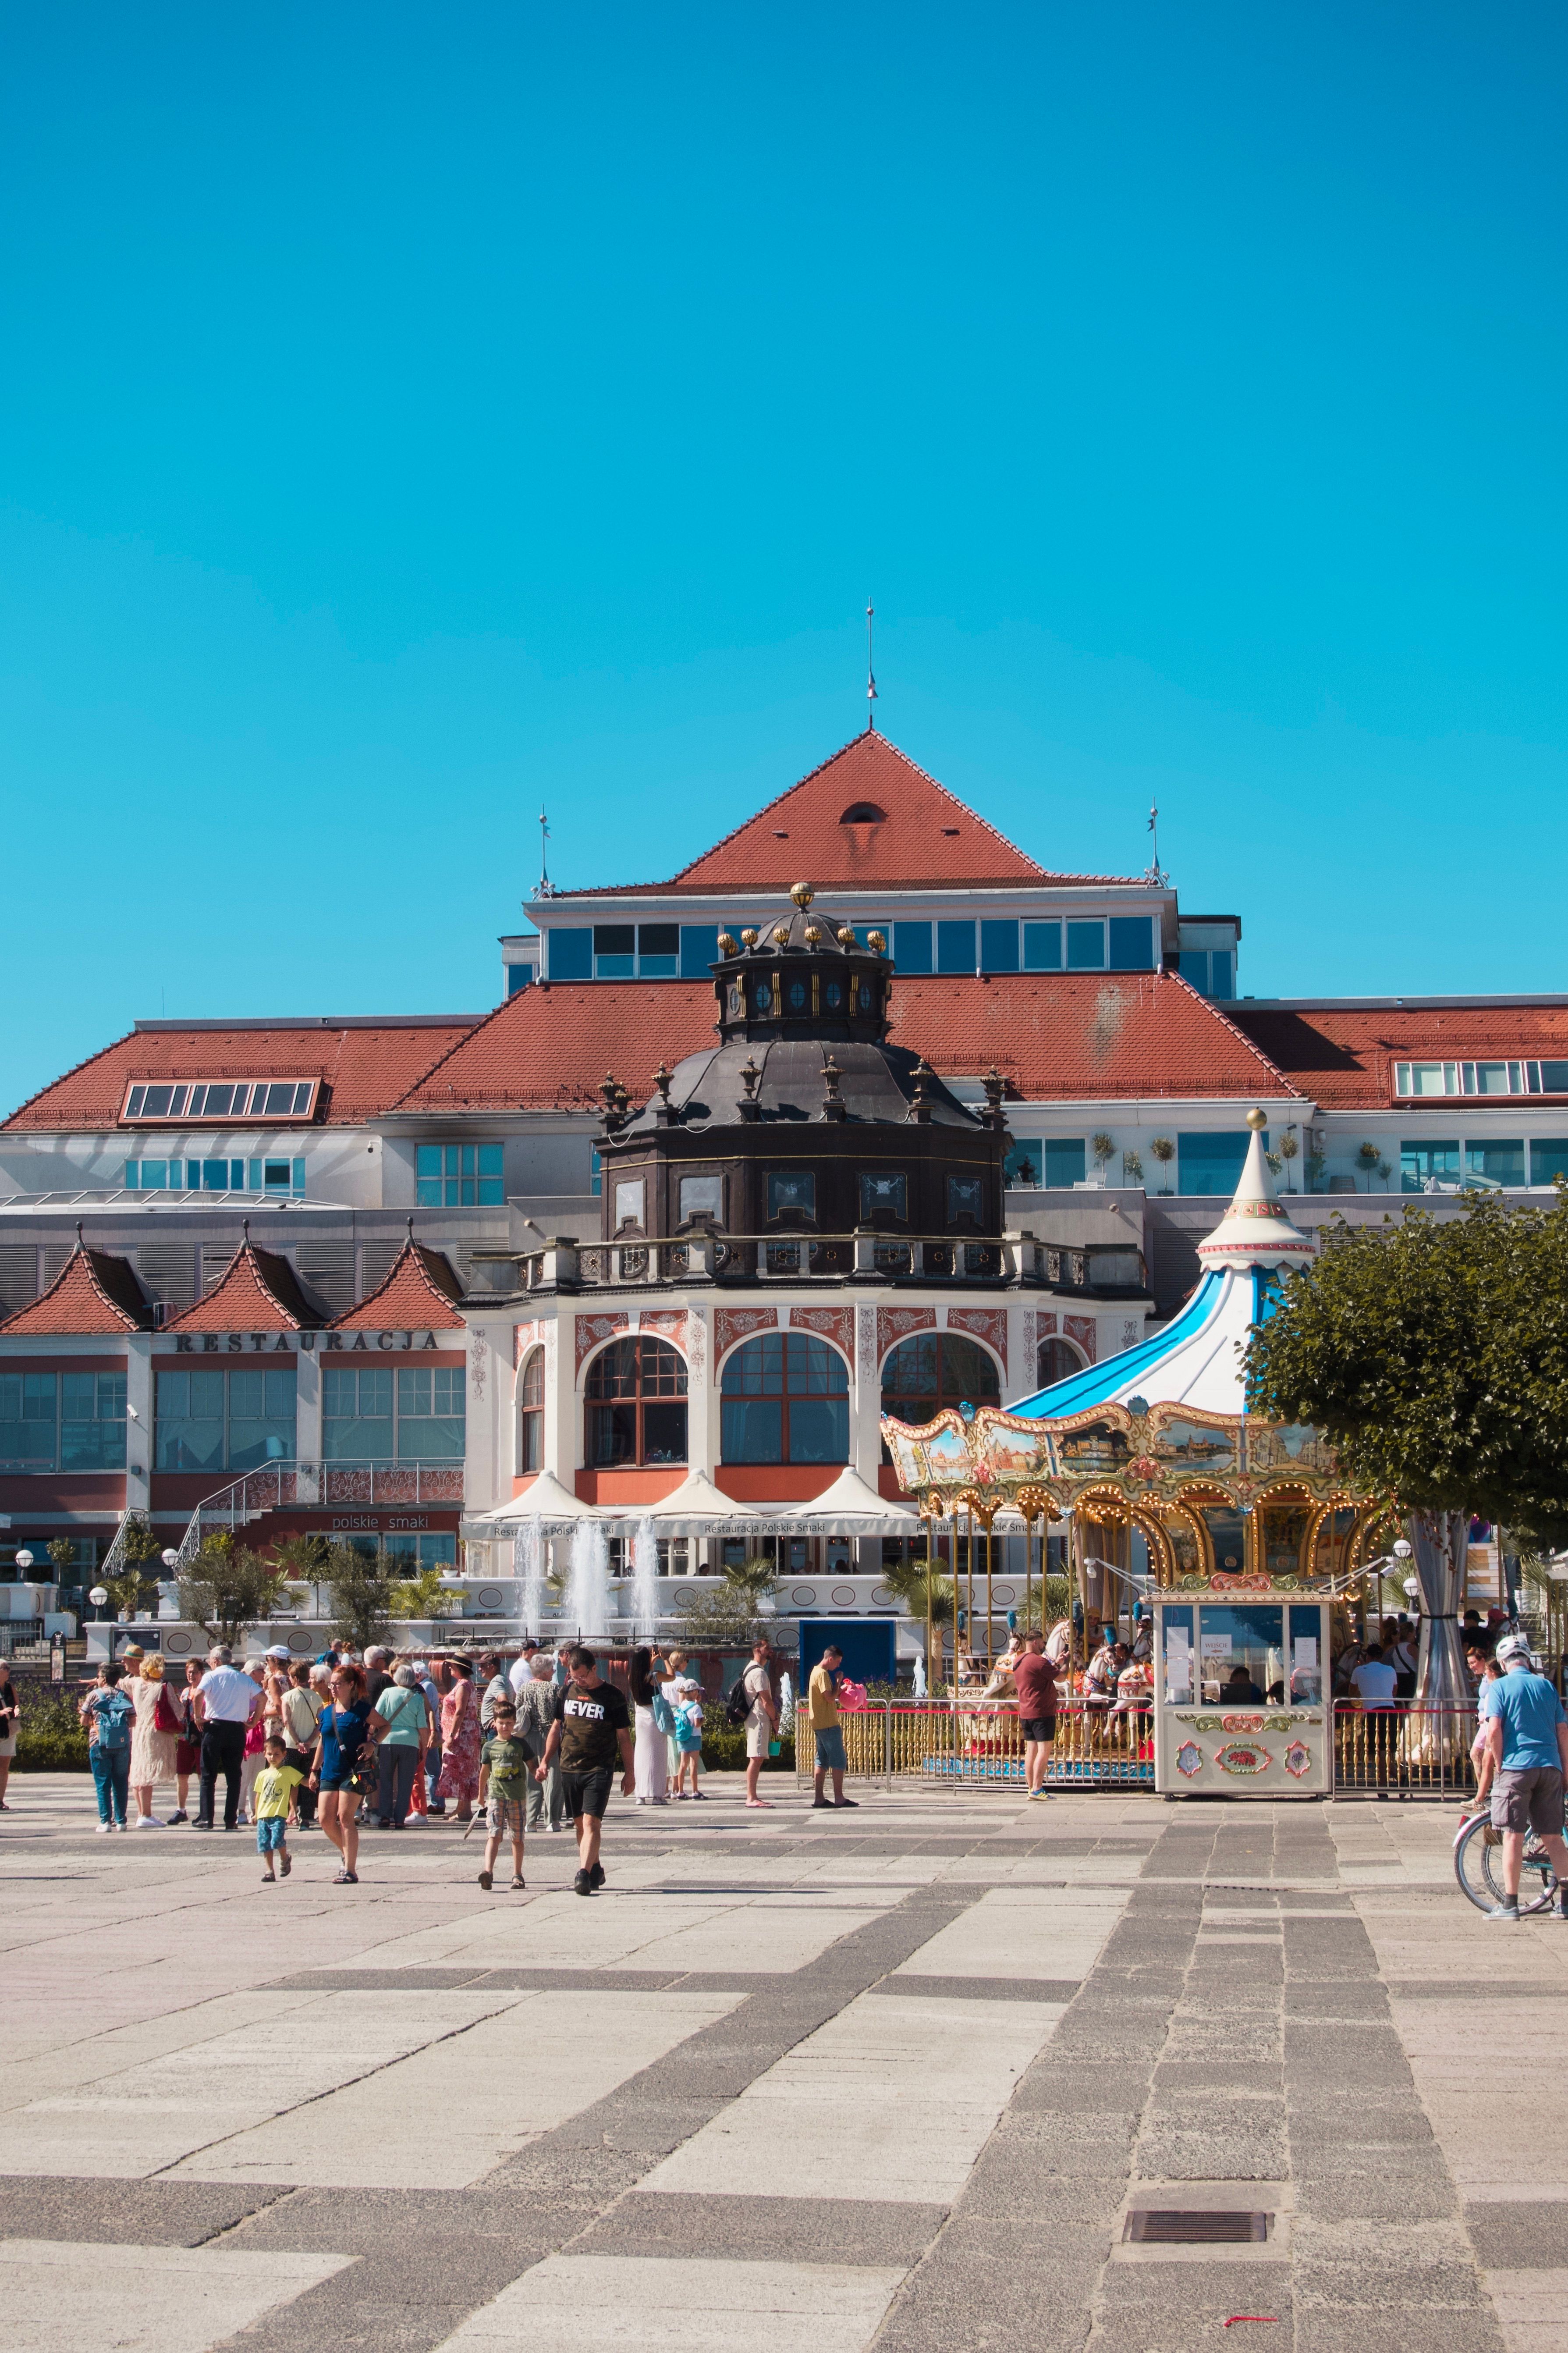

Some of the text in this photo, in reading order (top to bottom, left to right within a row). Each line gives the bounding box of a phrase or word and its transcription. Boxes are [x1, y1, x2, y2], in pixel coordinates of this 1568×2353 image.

[176, 1332, 439, 1352] RESTAURACJA
[333, 1515, 428, 1530] polskie smaki
[705, 1524, 759, 1533] Restauracja
[762, 1523, 794, 1532] Polskie
[917, 1523, 969, 1533] Restaurcj
[975, 1523, 1007, 1531] Pskie
[494, 1527, 547, 1536] Restaa
[551, 1526, 578, 1535] Polski
[564, 1699, 604, 1719] NEVER
